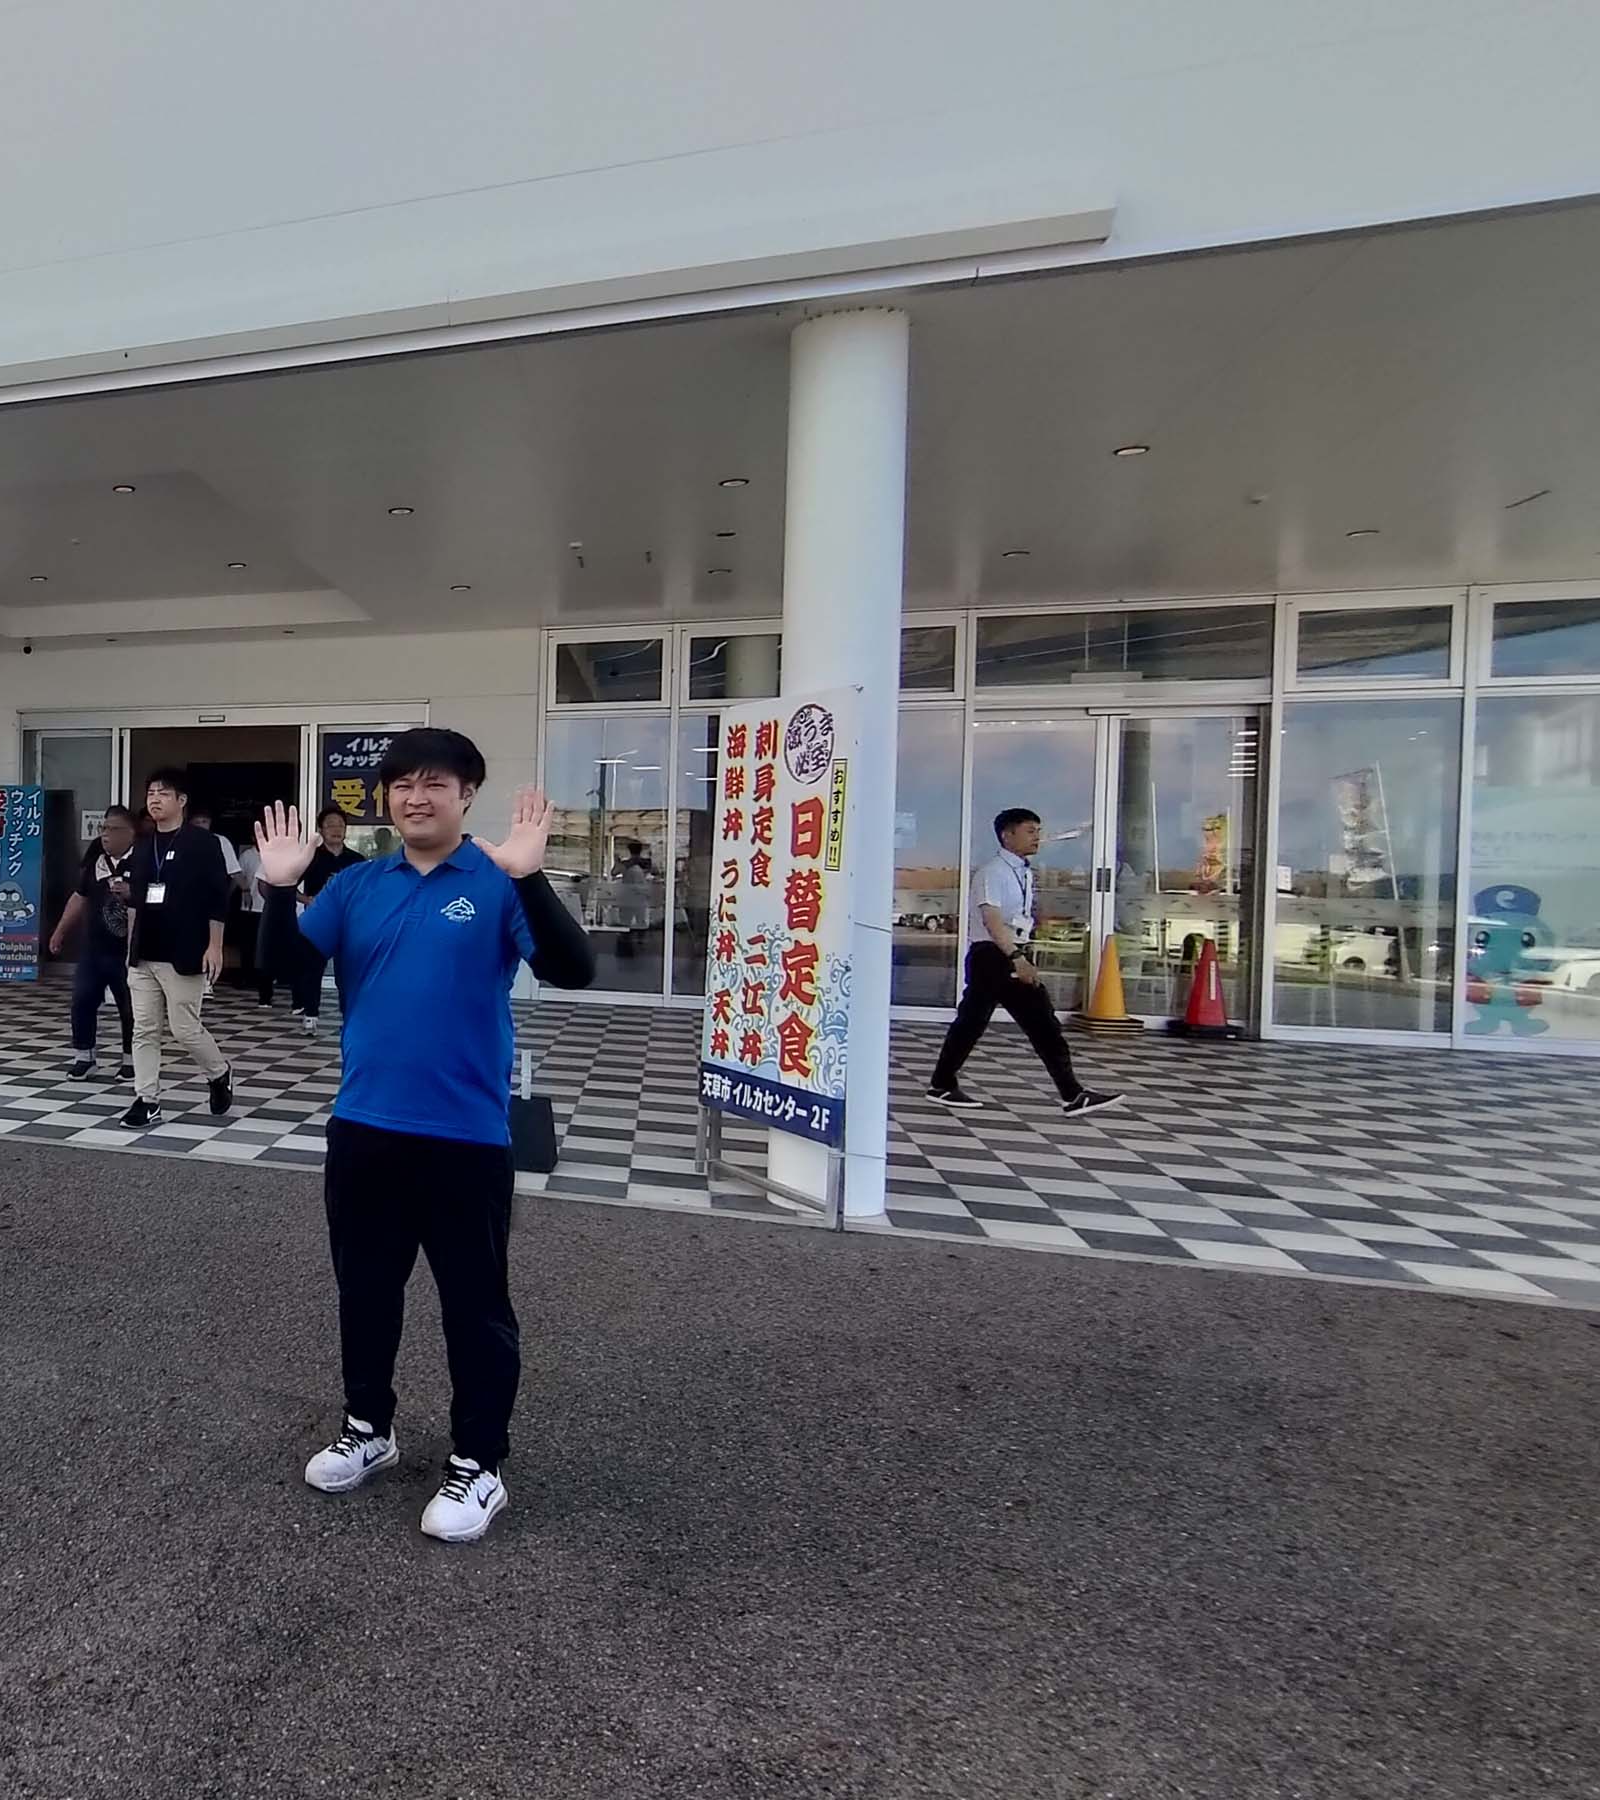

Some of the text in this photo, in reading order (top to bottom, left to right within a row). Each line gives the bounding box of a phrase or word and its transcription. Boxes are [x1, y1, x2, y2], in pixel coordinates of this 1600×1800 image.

[328, 752, 386, 767] ウォッチ
[722, 723, 747, 840] 海鮮丼
[26, 790, 41, 836] イルカ
[750, 719, 779, 888] 刺身定食
[714, 858, 740, 963] うに丼
[776, 796, 825, 1079] 日替定食
[0, 943, 32, 952] Dolphin
[0, 952, 38, 963] watching
[710, 988, 732, 1060] 天丼
[738, 933, 768, 1066] 二江丼
[810, 1104, 831, 1132] 2F
